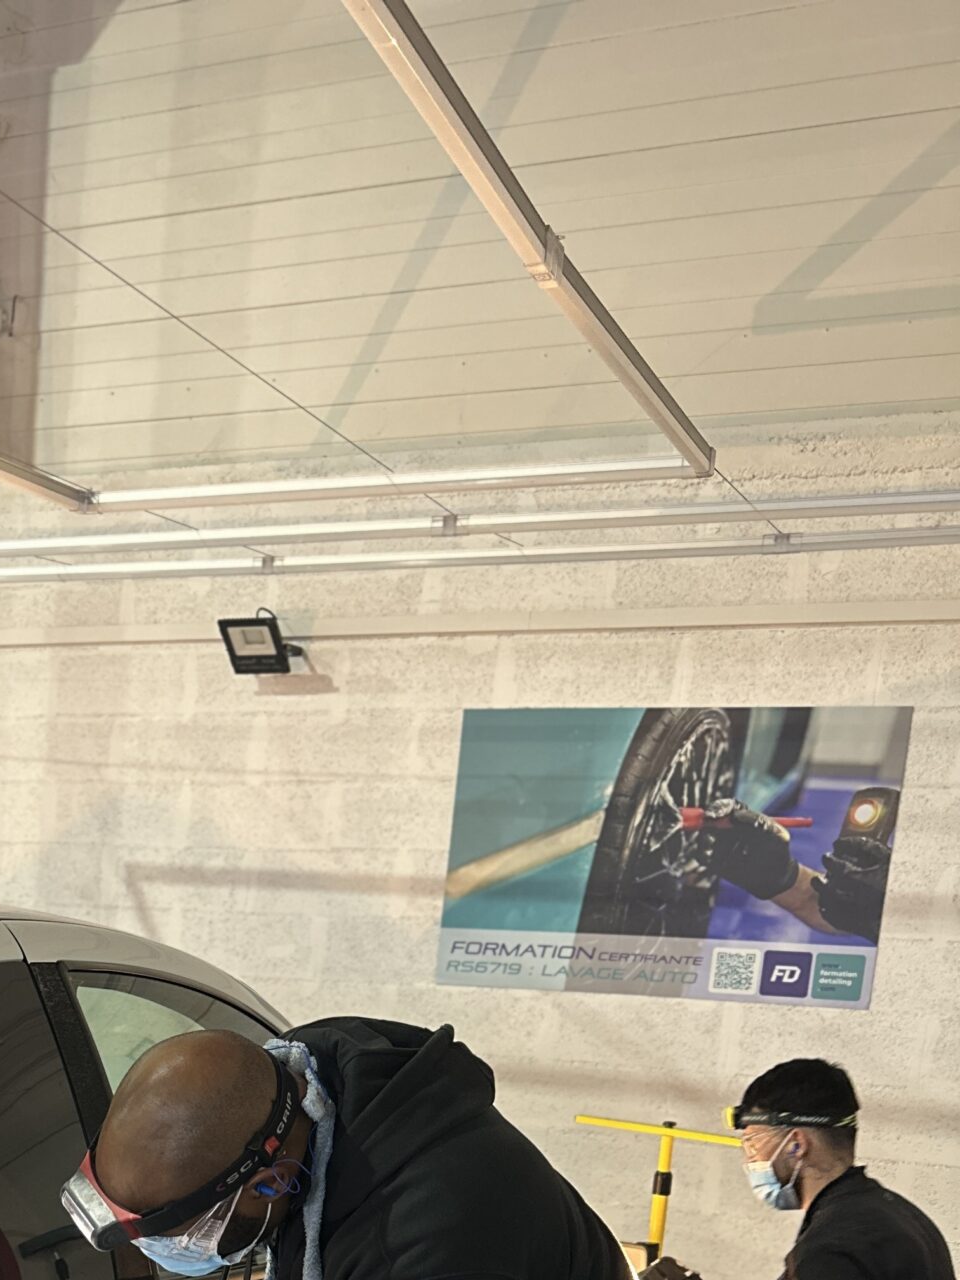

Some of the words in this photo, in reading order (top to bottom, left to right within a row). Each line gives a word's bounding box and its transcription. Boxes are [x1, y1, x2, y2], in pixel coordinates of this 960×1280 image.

[450, 940, 596, 960] FORMATION
[598, 951, 704, 966] CERTIFIANTE
[446, 960, 522, 976] RS6719
[541, 964, 624, 981] LAVAGE
[632, 969, 699, 985] AUTO
[770, 965, 801, 983] FD
[818, 977, 852, 987] detailing
[820, 969, 858, 978] formation
[276, 1091, 292, 1134] GRIP
